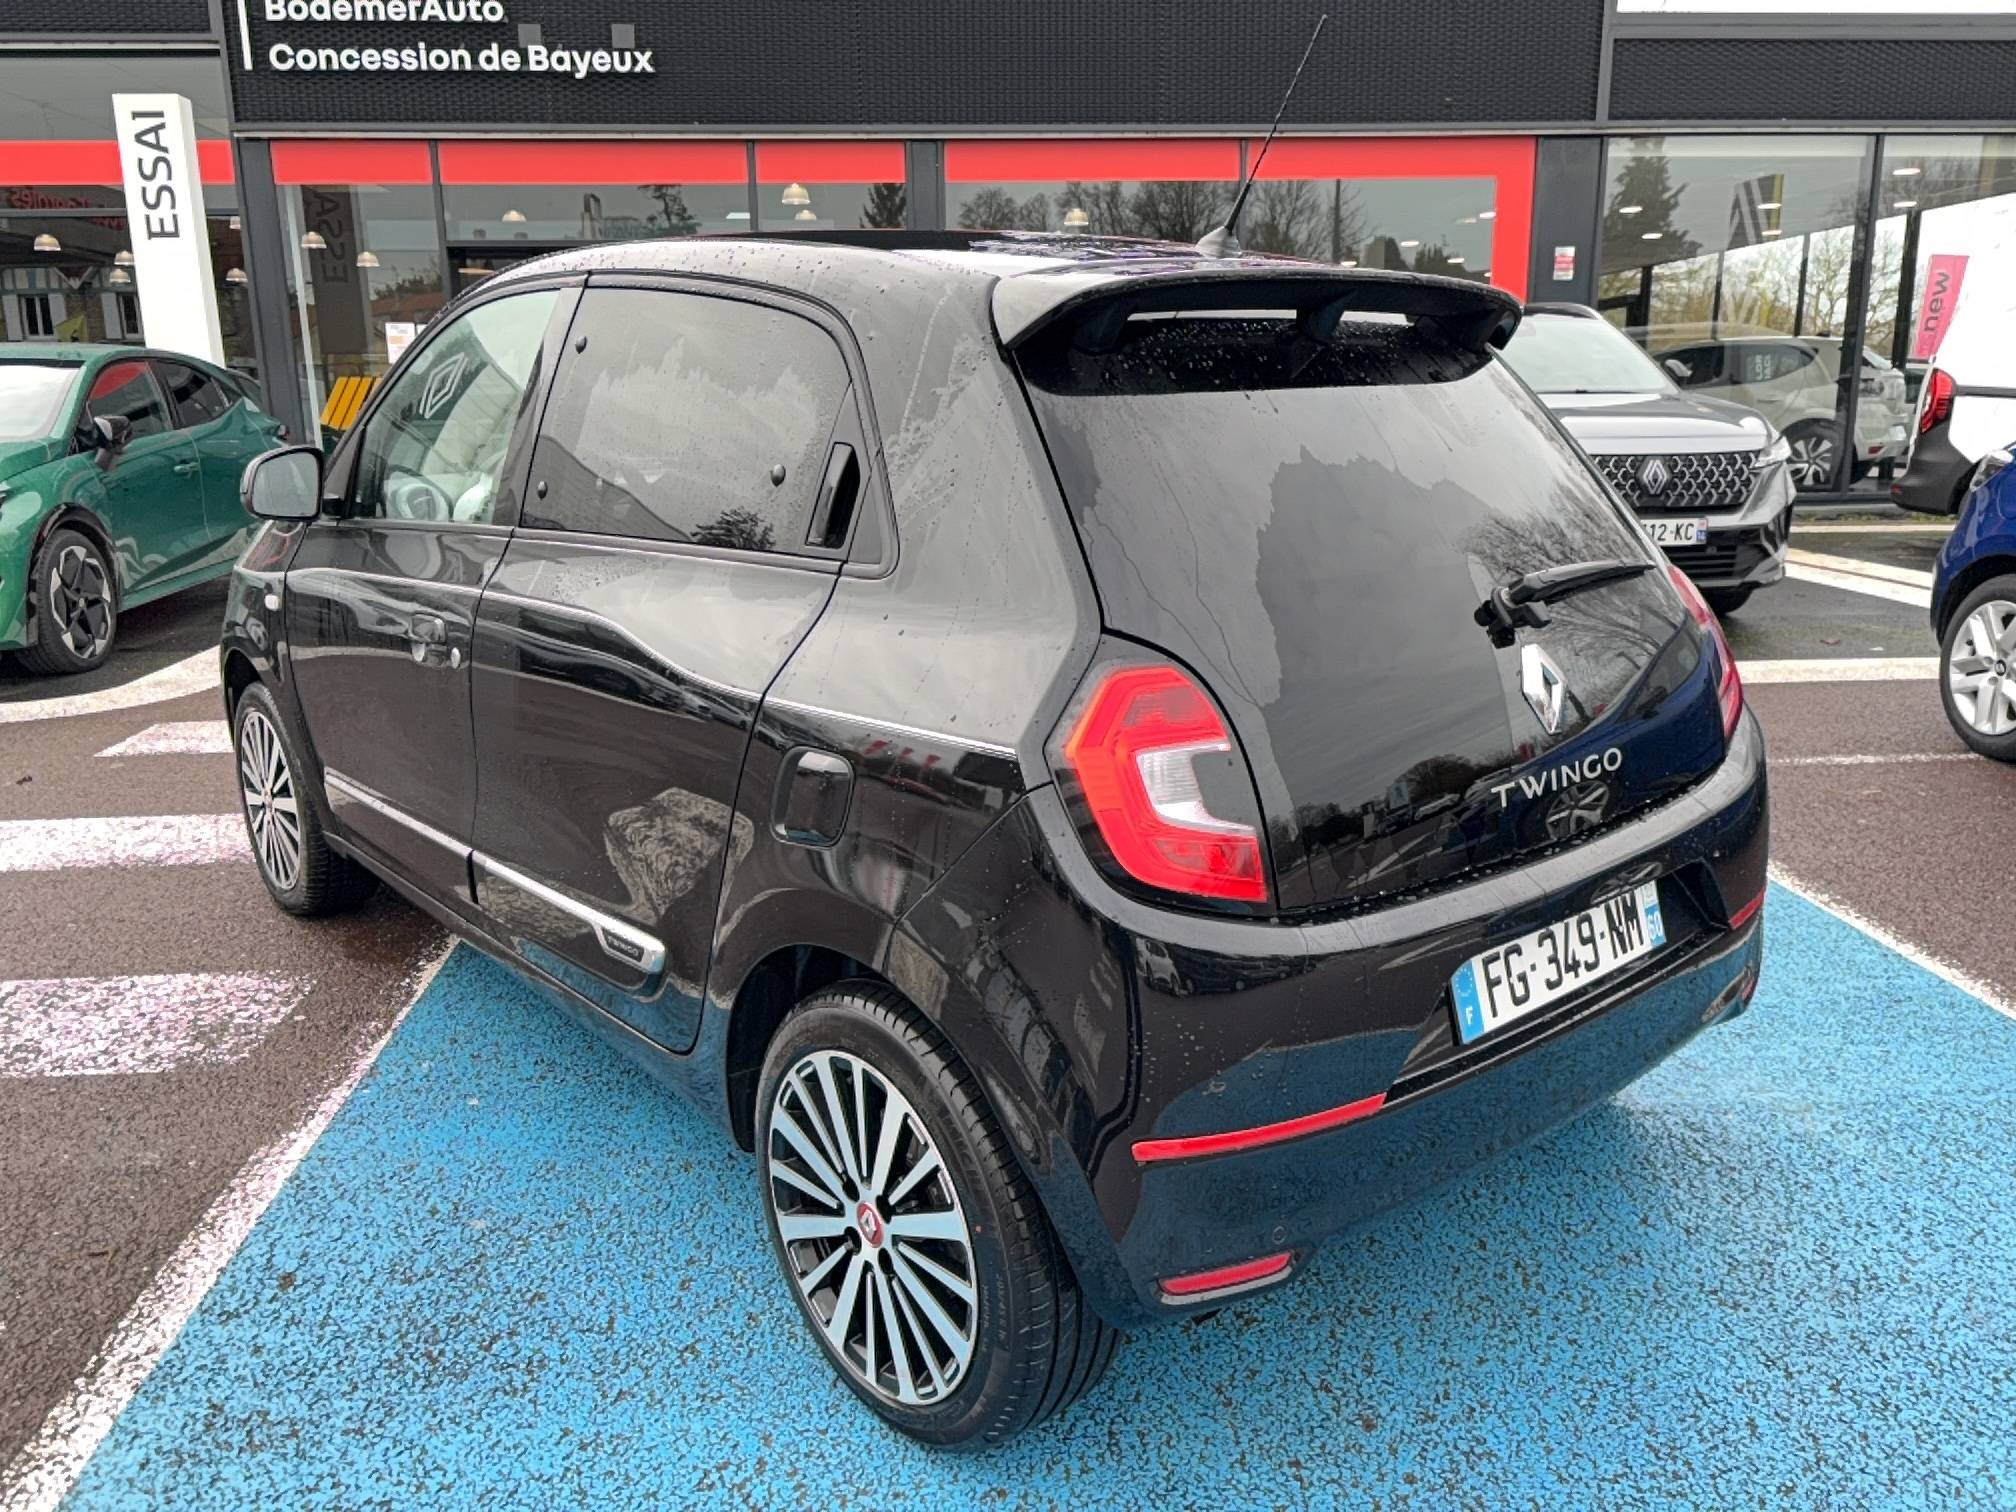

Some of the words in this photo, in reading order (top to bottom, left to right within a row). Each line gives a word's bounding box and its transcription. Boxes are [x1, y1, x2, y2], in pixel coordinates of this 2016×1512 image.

[265, 0, 505, 22] BodemerAuto
[269, 42, 472, 71] Concession
[478, 43, 522, 72] de
[527, 45, 656, 79] Bayeux
[131, 110, 180, 240] ESSAI
[1924, 271, 1950, 332] new
[1641, 523, 1694, 541] 12-KC
[1491, 748, 1622, 808] TWINGO
[1482, 889, 1644, 1018] FG-349-NM
[1465, 1006, 1473, 1025] F
